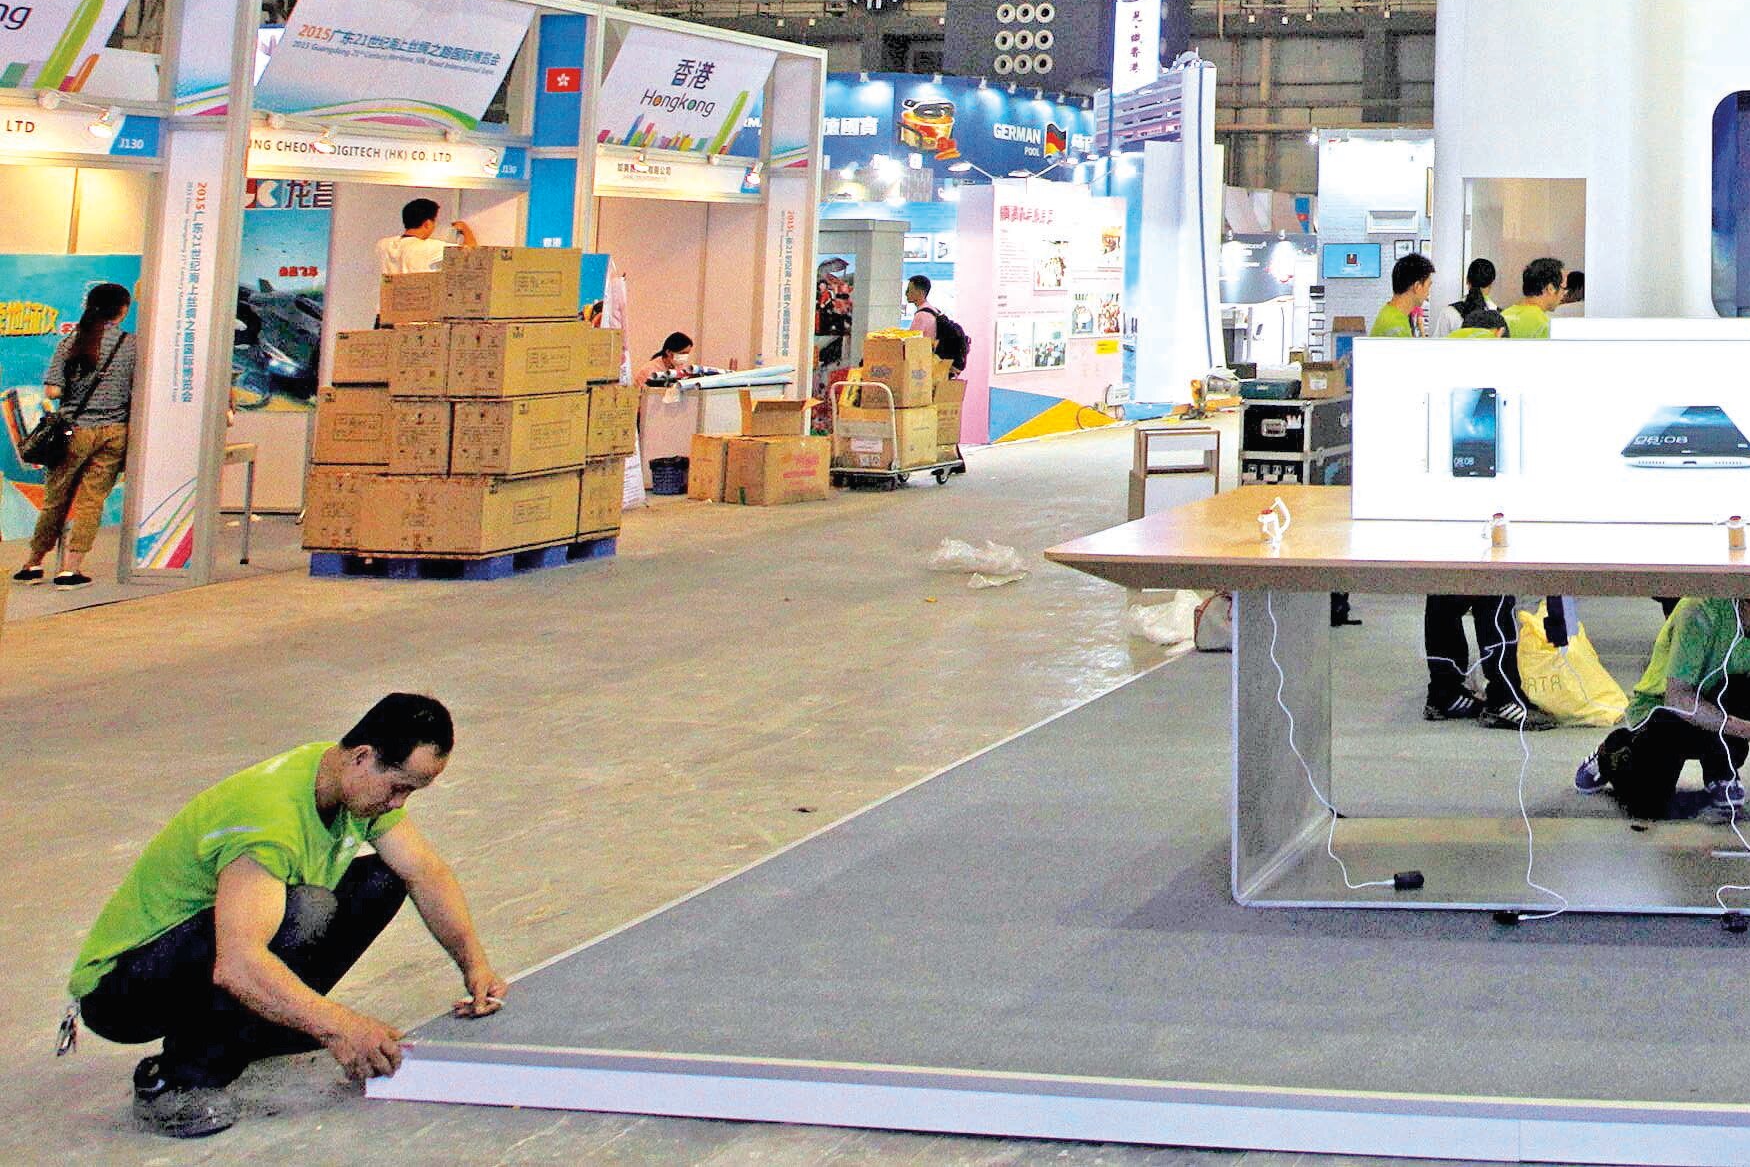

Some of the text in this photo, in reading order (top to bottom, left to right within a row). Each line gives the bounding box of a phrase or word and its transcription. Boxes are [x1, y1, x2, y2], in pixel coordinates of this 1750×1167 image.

[671, 58, 715, 90] 香港
[640, 88, 715, 117] Hongkong
[6, 119, 35, 133] LTD
[993, 122, 1042, 145] GERMAN
[384, 148, 408, 162] (HK)
[432, 152, 452, 163] LTD
[1024, 146, 1040, 157] POOL
